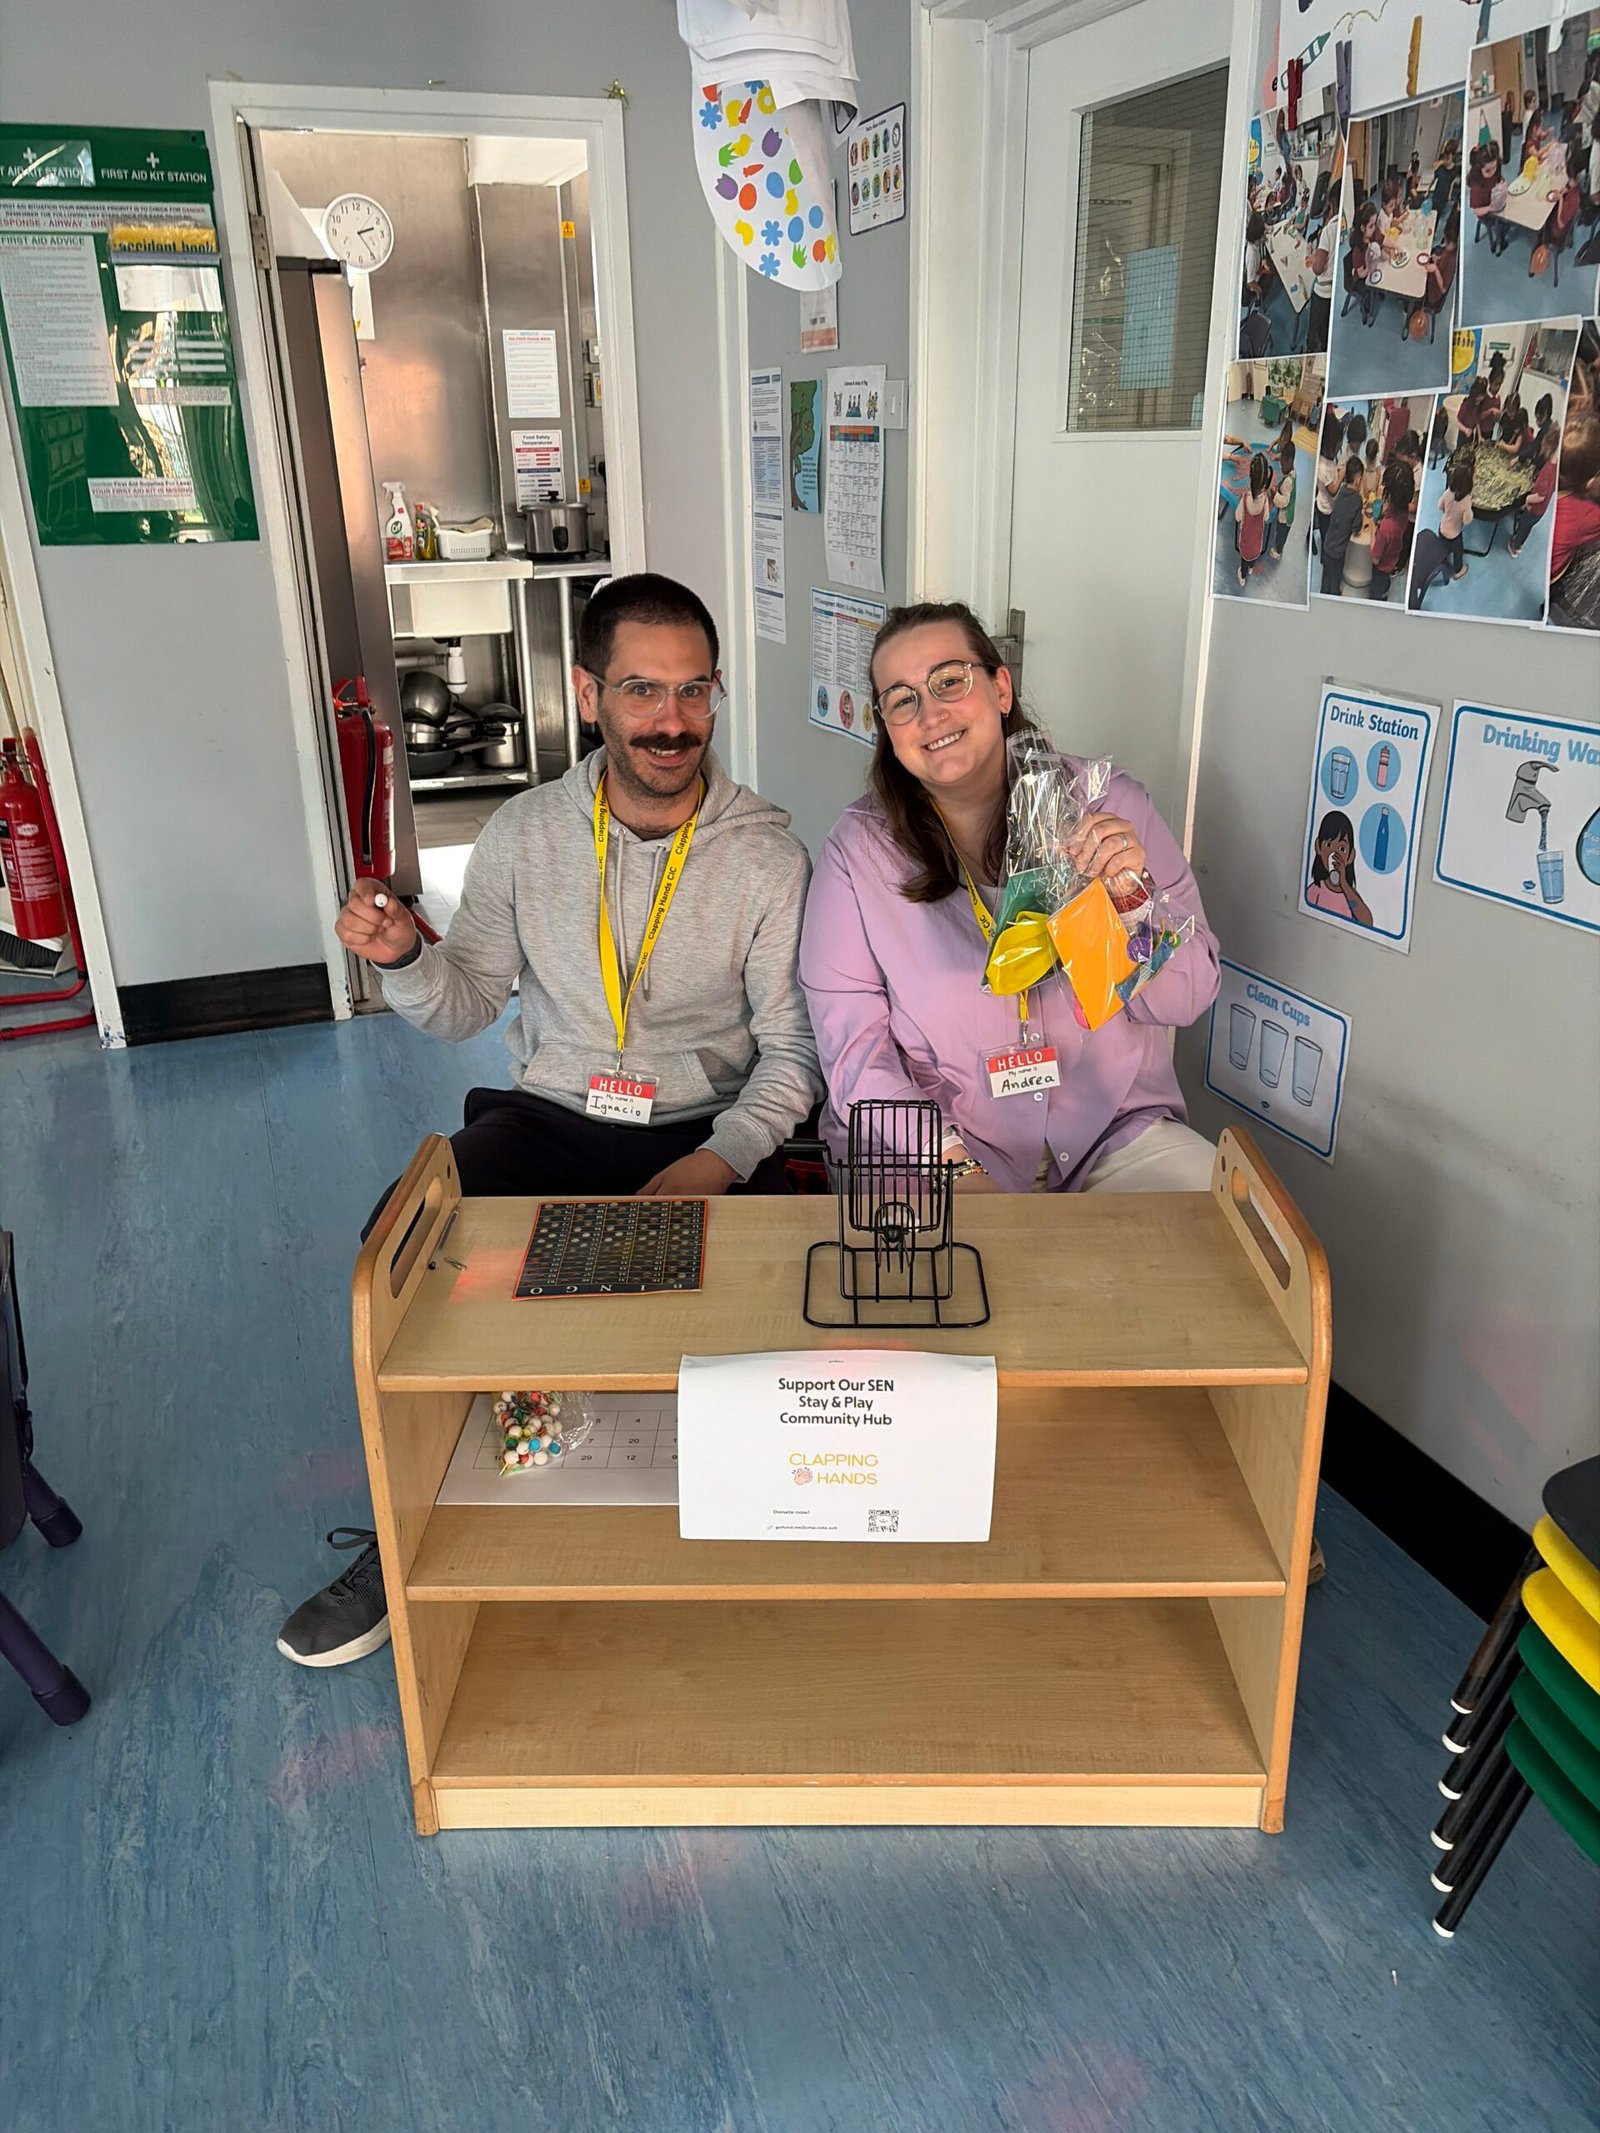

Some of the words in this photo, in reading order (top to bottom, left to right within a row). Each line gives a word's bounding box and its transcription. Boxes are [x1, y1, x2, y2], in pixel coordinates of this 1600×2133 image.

[101, 168, 128, 179] FIRST
[132, 170, 147, 180] AID
[150, 170, 165, 181] KIT
[167, 171, 207, 183] STATION
[341, 205, 348, 214] 11
[352, 202, 360, 211] 12
[367, 207, 370, 215] 1
[49, 219, 83, 228] AIRWAY
[332, 215, 341, 224] 10
[376, 217, 381, 225] 2
[332, 228, 337, 237] 9
[2, 236, 28, 245] FIRST
[32, 236, 47, 245] AID
[50, 236, 84, 246] ADVICE
[346, 251, 351, 259] 7
[112, 487, 131, 495] FIRST
[165, 486, 193, 494] MISSING
[1330, 705, 1364, 728] Drink
[1368, 714, 1419, 740] Station
[1483, 724, 1561, 763] Drinking
[1568, 738, 1600, 767] Wa
[598, 808, 608, 842] Clapping
[675, 821, 693, 855] Clapping
[648, 906, 665, 940] Clapping
[659, 881, 672, 908] Hands
[668, 866, 677, 881] CIC
[979, 915, 990, 929] CIC
[640, 951, 649, 965] CIC
[1247, 983, 1278, 1011] Clean
[1282, 1000, 1310, 1027] Cups
[997, 1051, 1043, 1071] HELLO
[599, 1078, 643, 1095] HELLO
[1001, 1075, 1055, 1093] Andrea
[590, 1096, 641, 1116] Ignacio
[530, 1287, 543, 1295] O
[600, 1284, 612, 1292] N
[778, 1378, 835, 1393] Support
[838, 1379, 865, 1391] Our
[868, 1379, 894, 1392] SEN
[799, 1396, 829, 1410] Stay
[831, 1396, 841, 1408] &
[844, 1396, 873, 1411] Play
[780, 1412, 860, 1427] Community
[864, 1413, 892, 1425] Hub
[789, 1453, 878, 1467] CLAPPING
[817, 1472, 878, 1485] HANDS
